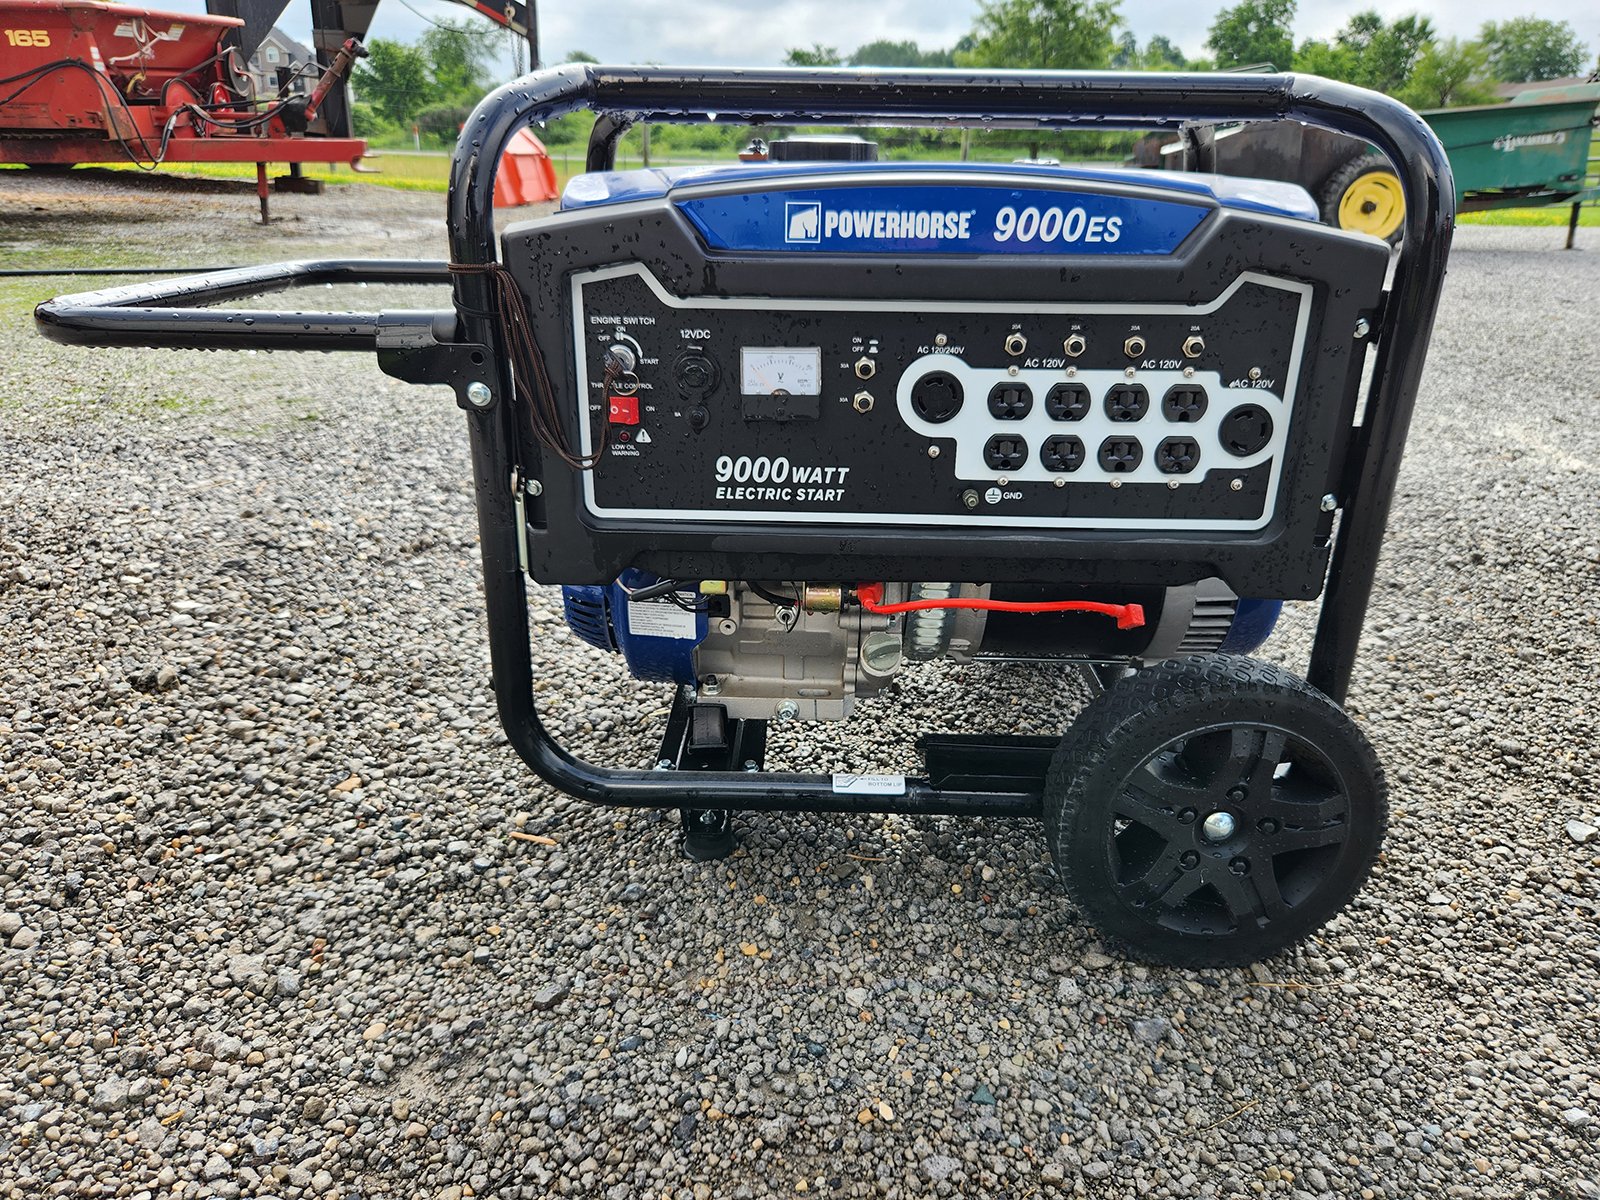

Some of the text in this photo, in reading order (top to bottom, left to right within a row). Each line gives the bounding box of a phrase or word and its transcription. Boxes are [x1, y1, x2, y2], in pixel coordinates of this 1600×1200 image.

[4, 29, 51, 47] 165
[825, 209, 971, 239] POWERHORSE
[590, 316, 656, 325] ENGINE SWITCH
[680, 329, 711, 339] 12VDC
[917, 346, 965, 355] AC 120/240V
[1024, 359, 1066, 368] AC 120V
[1140, 360, 1183, 369] AC 120V
[1234, 379, 1275, 388] AC 120V
[792, 466, 850, 484] WATT
[715, 487, 845, 501] ELECTRIC START
[1002, 491, 1023, 500] GND
